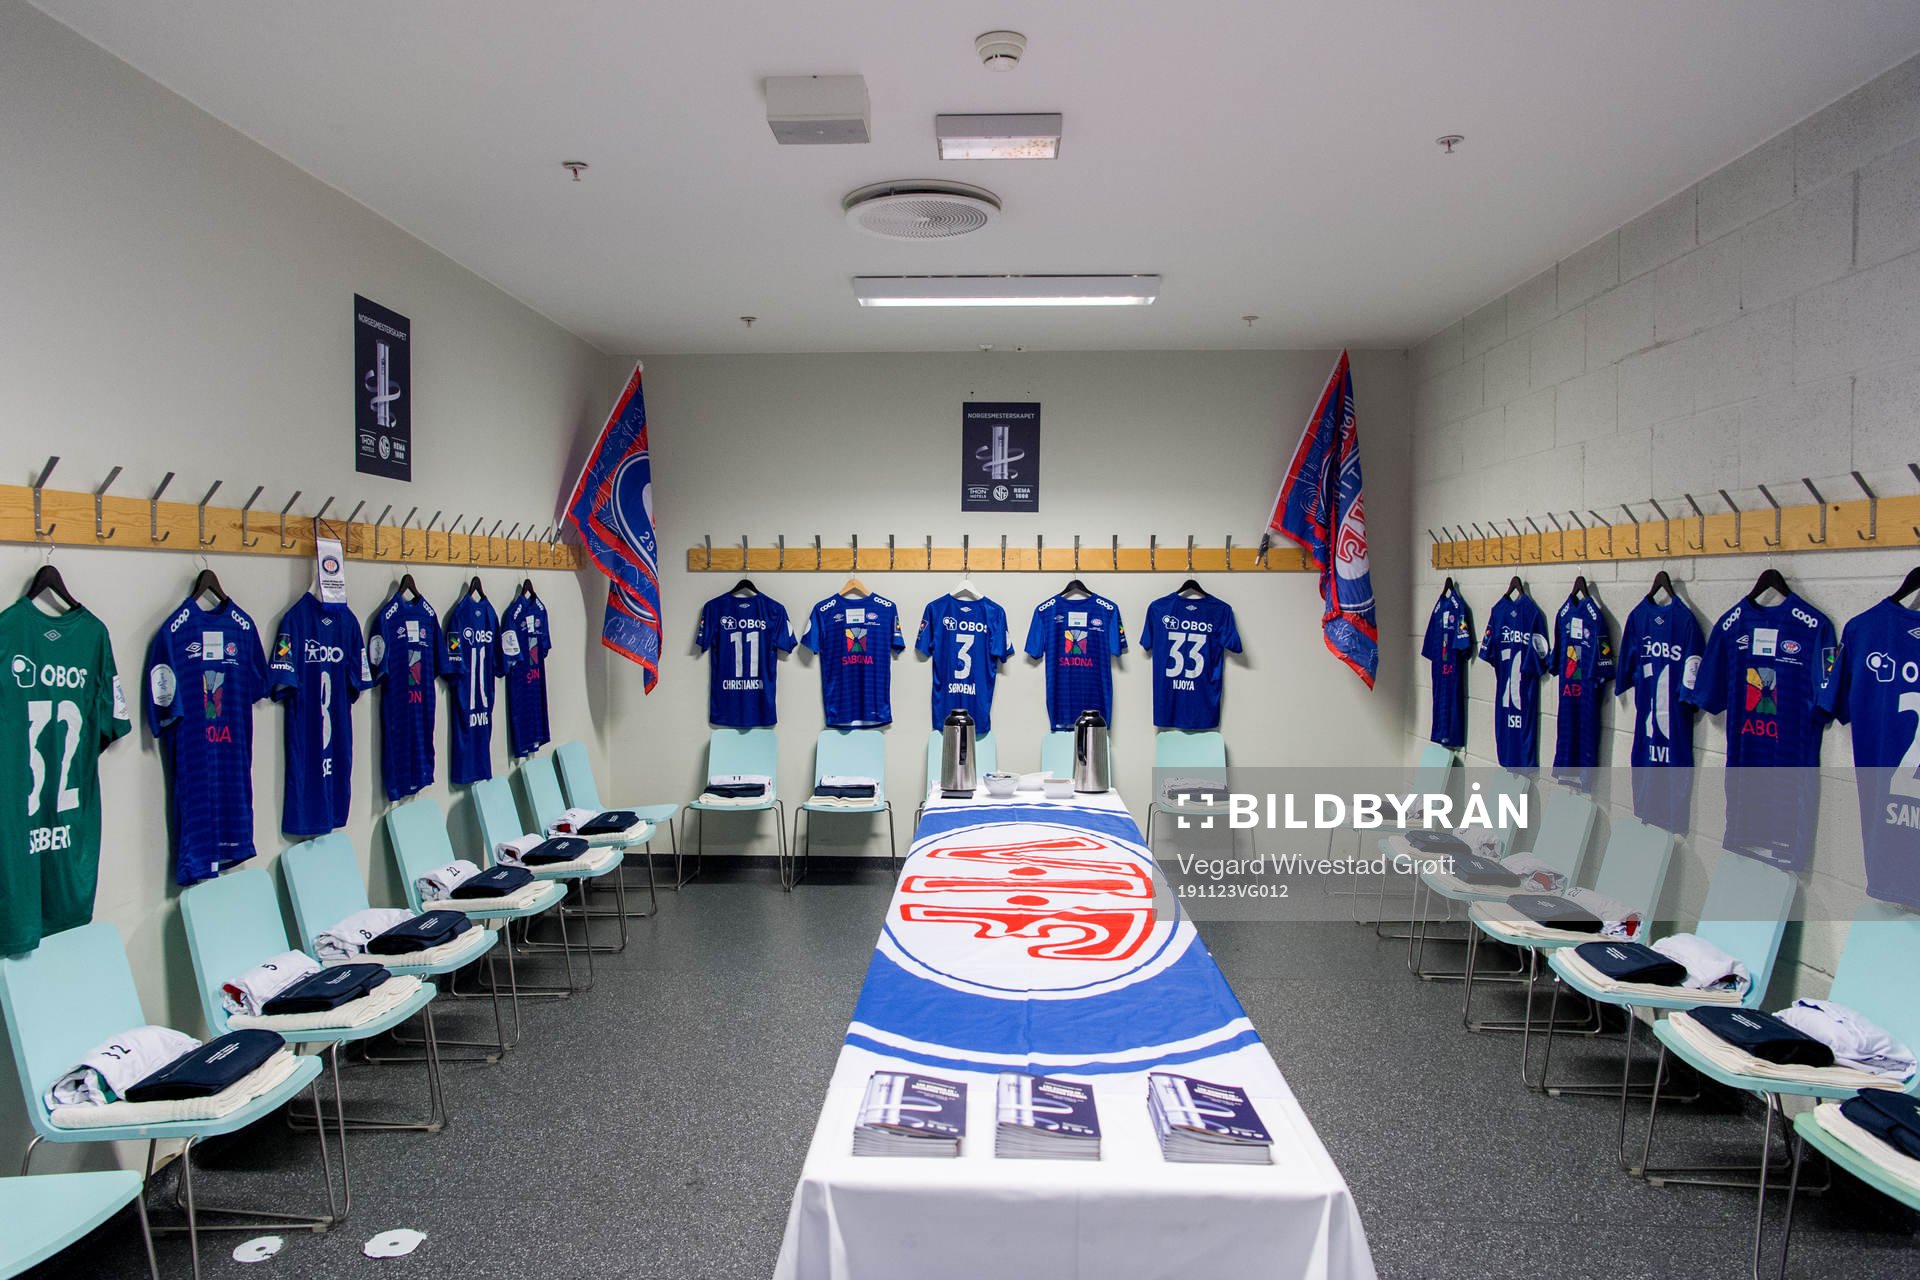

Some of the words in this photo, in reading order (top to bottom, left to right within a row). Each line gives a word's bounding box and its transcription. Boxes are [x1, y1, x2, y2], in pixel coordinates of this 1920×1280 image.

[170, 608, 190, 633] coop
[231, 610, 250, 631] coop
[1180, 620, 1213, 633] OBOS
[1722, 607, 1742, 631] coop
[1791, 607, 1819, 628] coop
[730, 631, 760, 678] 11
[954, 633, 975, 679] 3
[1165, 631, 1207, 679] 33
[40, 663, 88, 689] OBOS
[359, 929, 373, 940] 8
